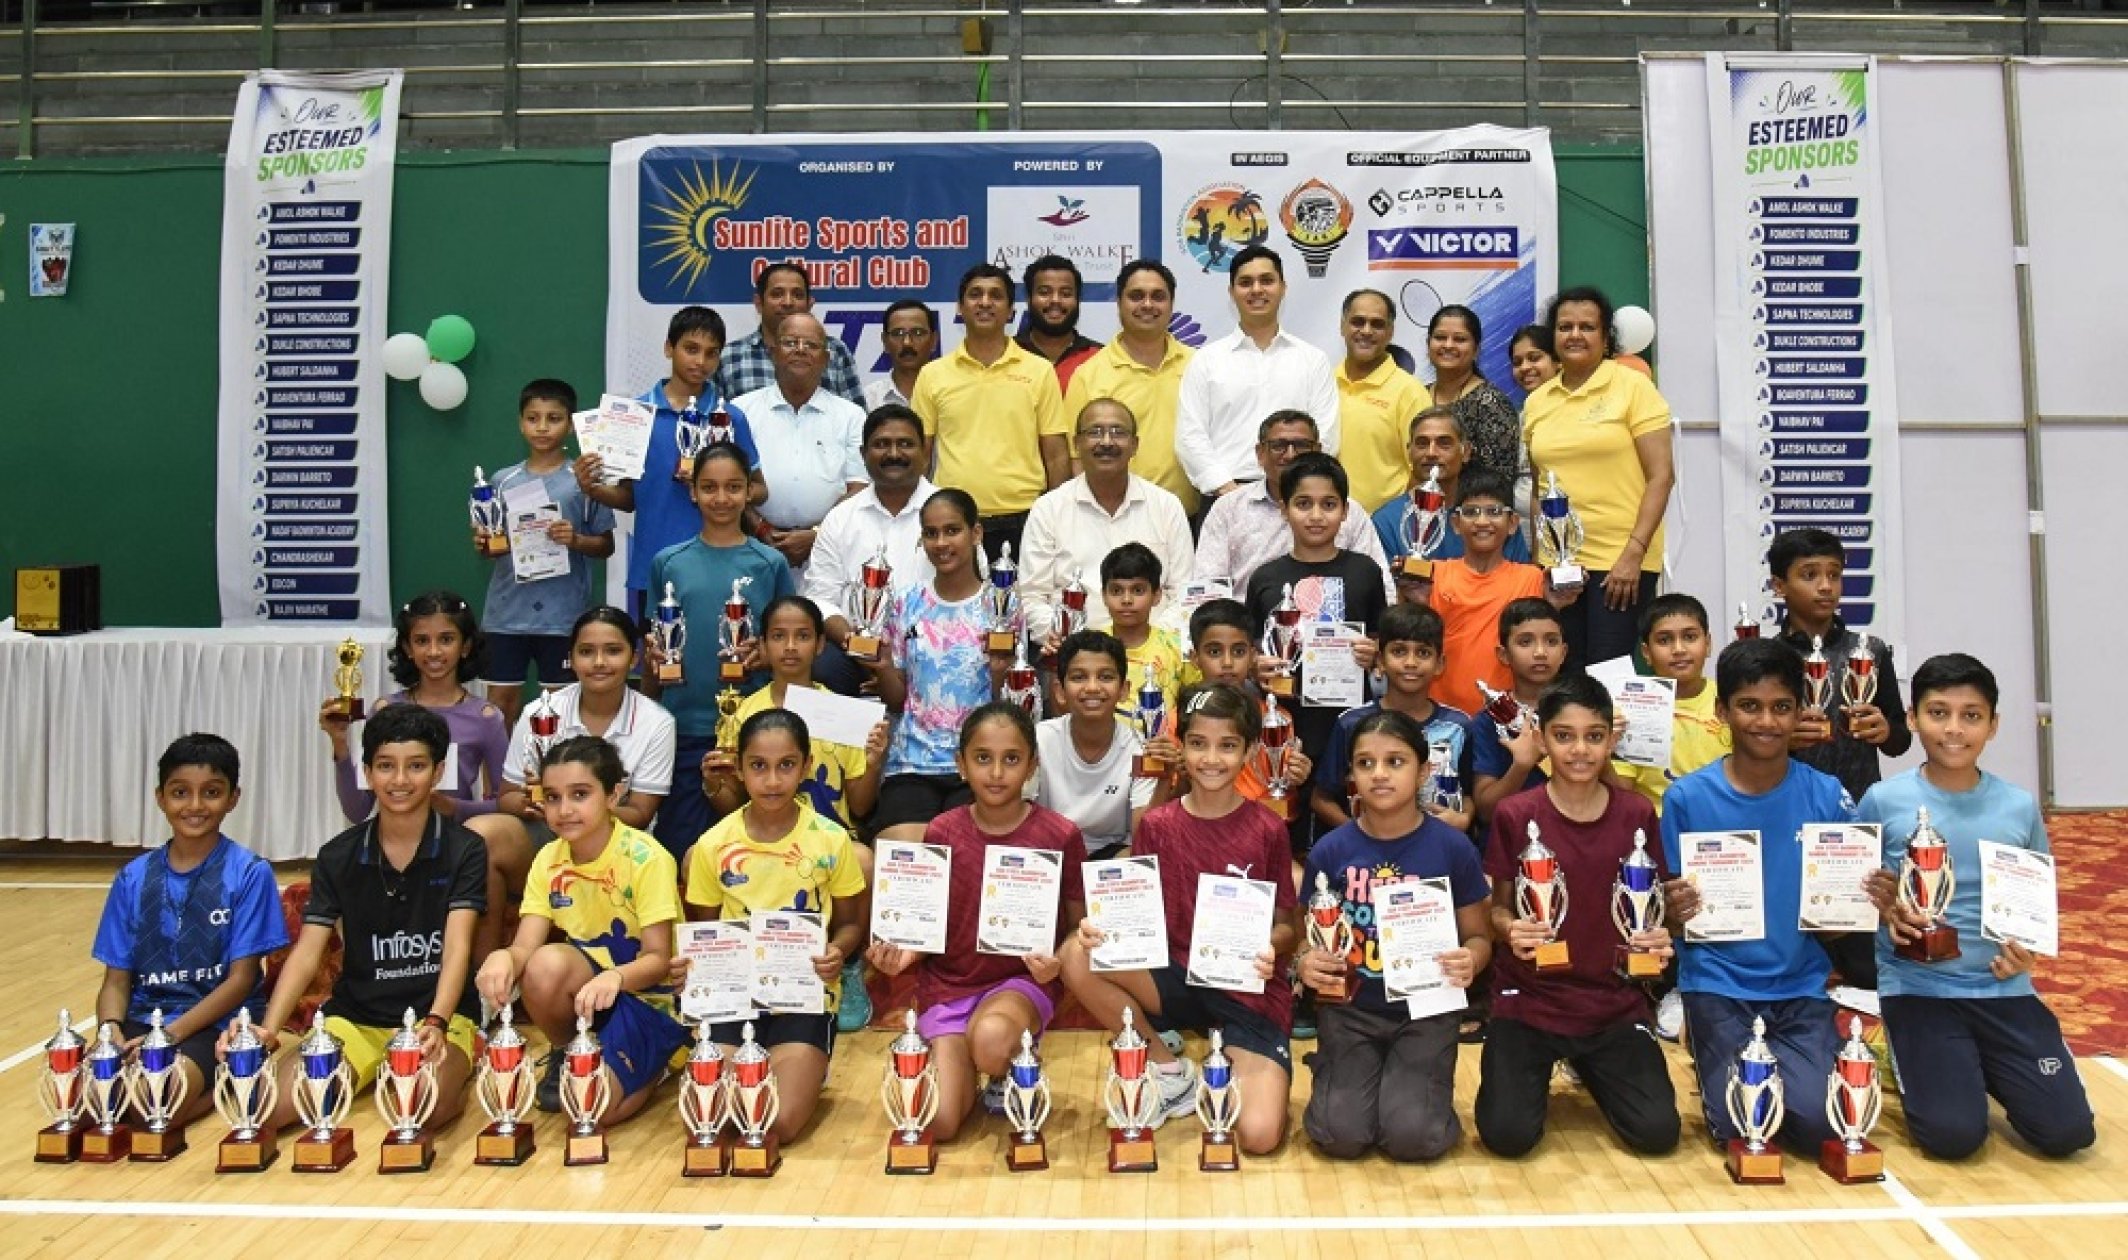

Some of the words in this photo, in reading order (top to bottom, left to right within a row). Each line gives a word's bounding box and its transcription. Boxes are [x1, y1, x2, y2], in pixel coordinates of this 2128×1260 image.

[263, 126, 364, 154] ESTEEMED
[1749, 114, 1848, 145] ESTEEMED
[257, 146, 367, 182] SPONSORS
[799, 161, 873, 173] ORGANISED
[877, 160, 895, 172] BY
[1014, 160, 1079, 172] POWERED
[1086, 159, 1104, 171] BY
[1234, 154, 1248, 164] IN
[1350, 153, 1401, 165] OFFICIAL
[1474, 149, 1528, 162] PARTNER
[1745, 139, 1859, 175] SPONSORS
[1397, 187, 1503, 201] CAPPELLA
[1397, 202, 1505, 215] SPORTS
[1791, 202, 1818, 214] ASHOK
[1819, 202, 1844, 214] WALKE
[714, 216, 810, 248] Sunlite
[817, 216, 909, 253] Sports
[916, 215, 968, 248] and
[1410, 232, 1512, 253] VICTOR
[994, 244, 1057, 268] ASHOK
[868, 256, 930, 289] Club
[371, 929, 442, 961] Infosys
[375, 961, 441, 980] Foundatio
